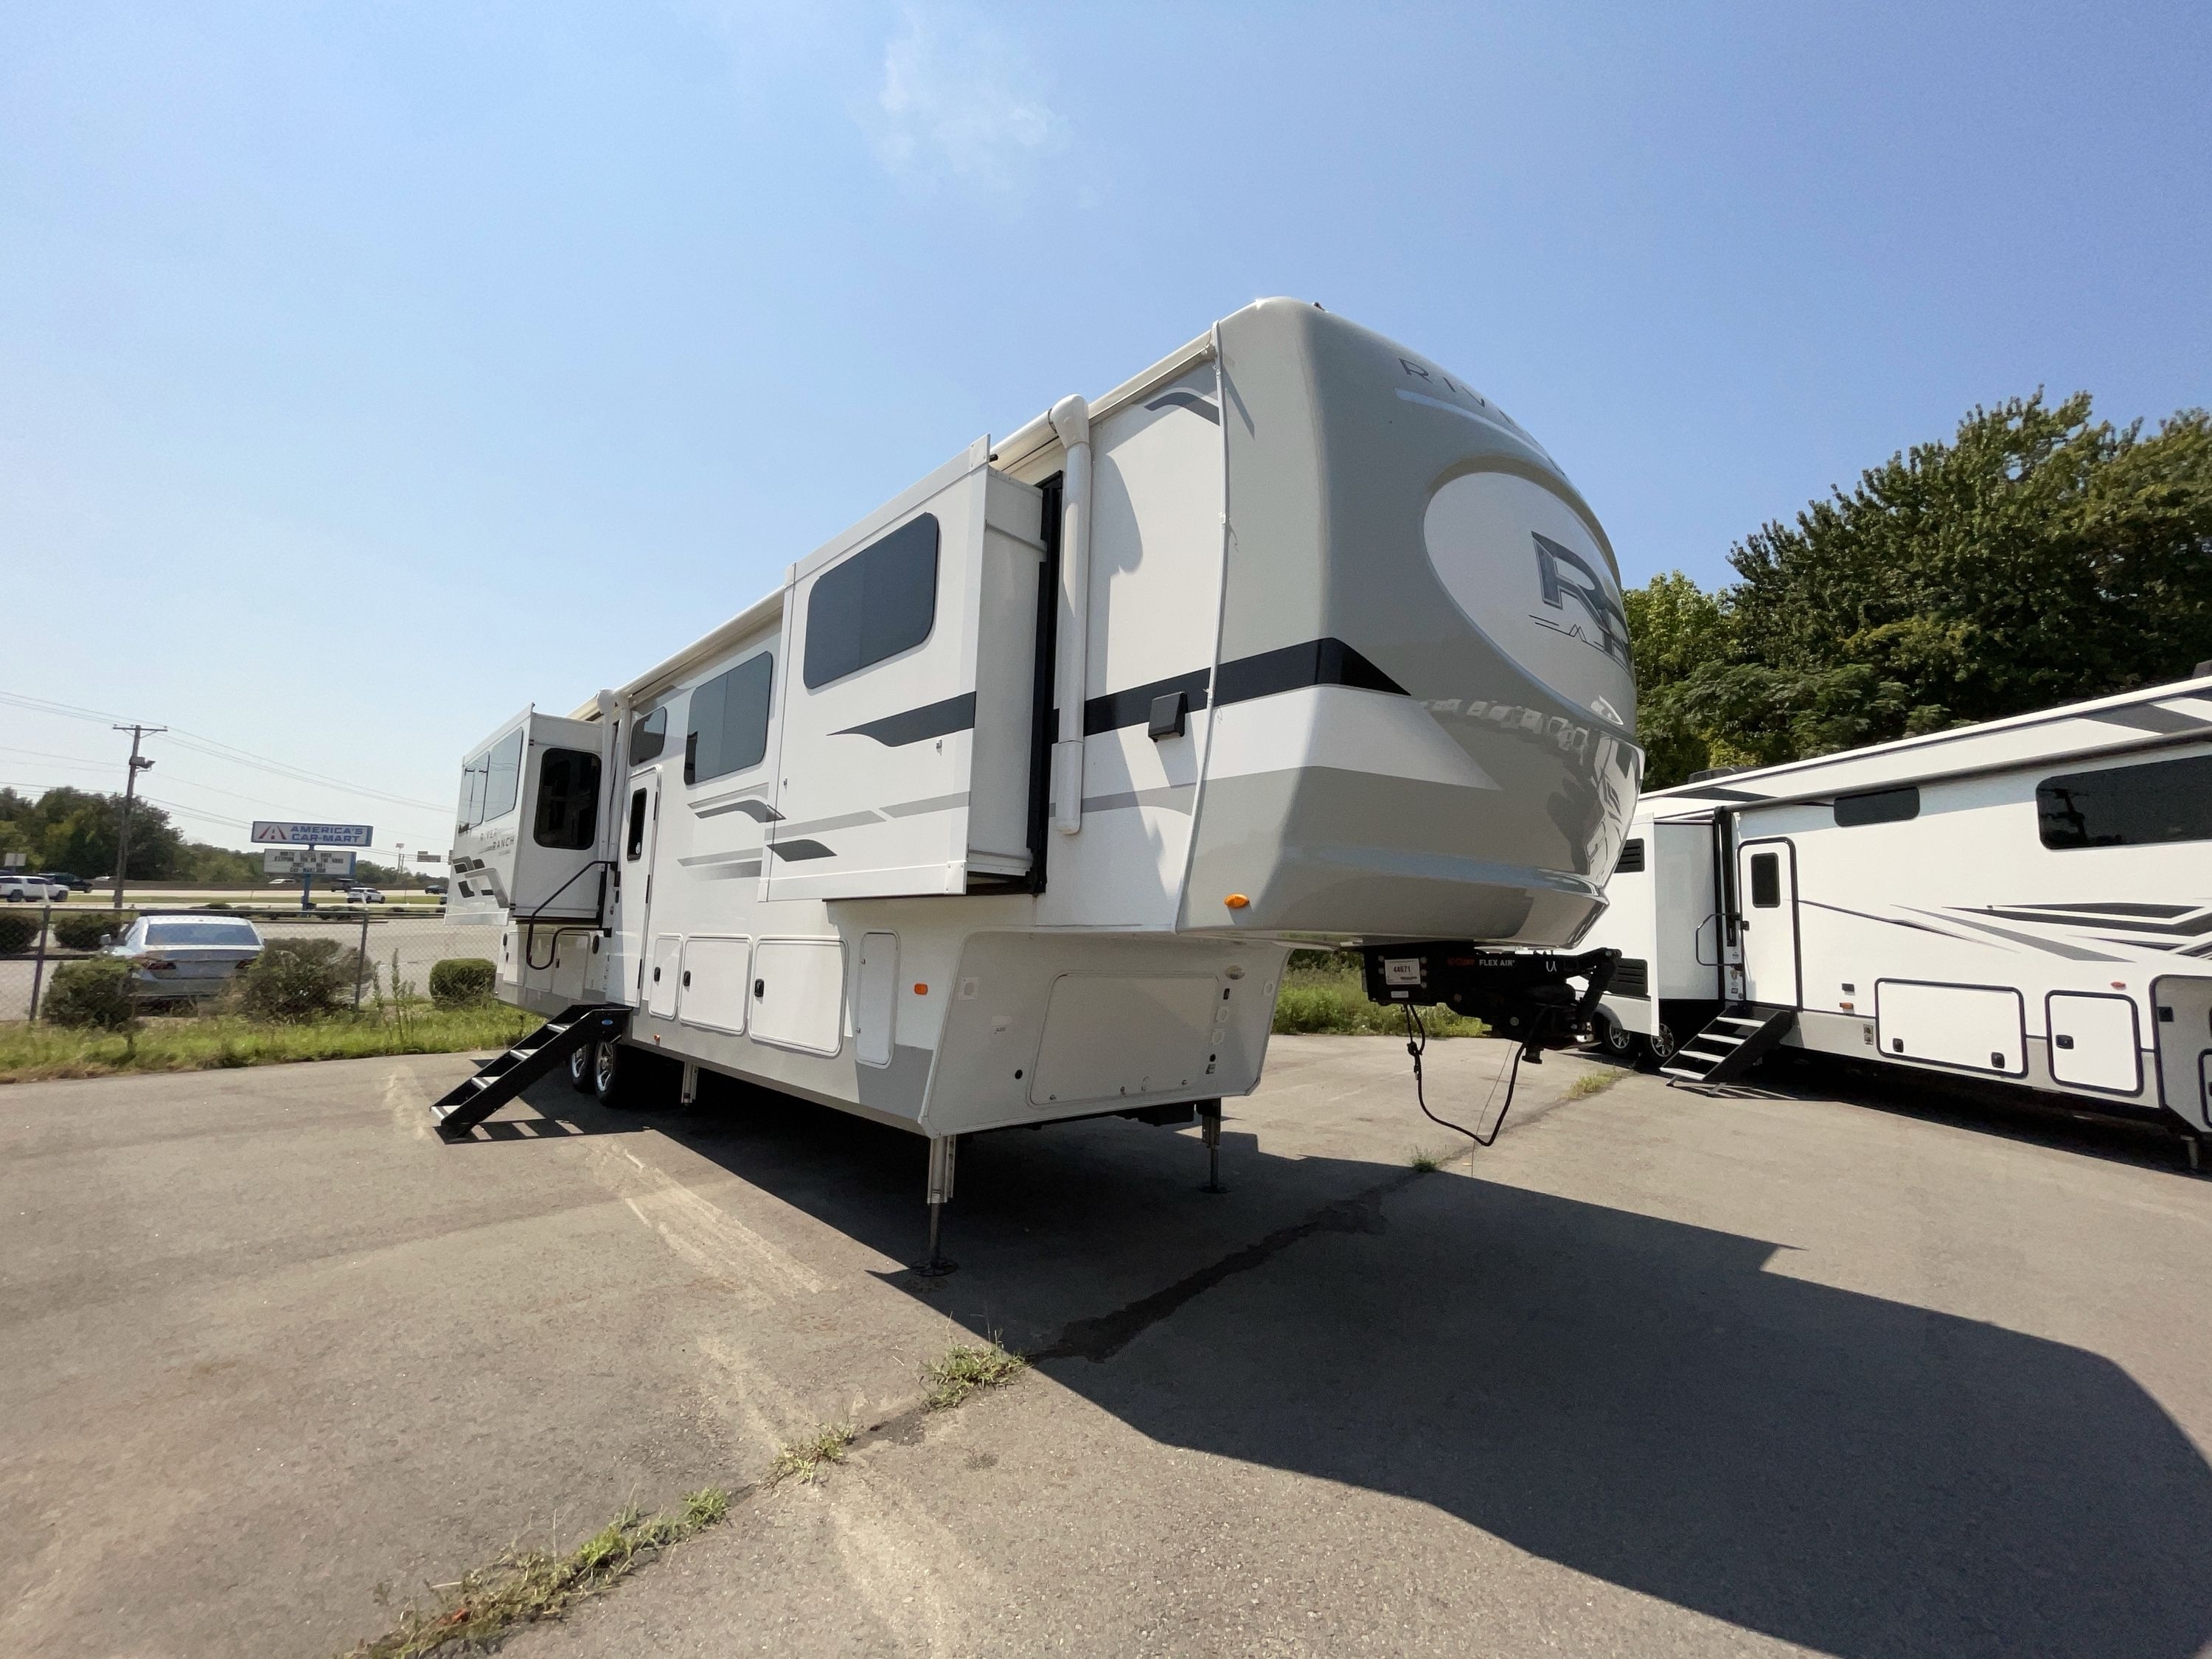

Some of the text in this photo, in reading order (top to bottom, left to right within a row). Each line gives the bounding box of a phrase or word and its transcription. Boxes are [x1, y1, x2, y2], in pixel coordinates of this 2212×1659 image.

[291, 825, 364, 835] AMERICA'S
[291, 834, 361, 843] CAR-MART
[493, 835, 515, 850] RANCH
